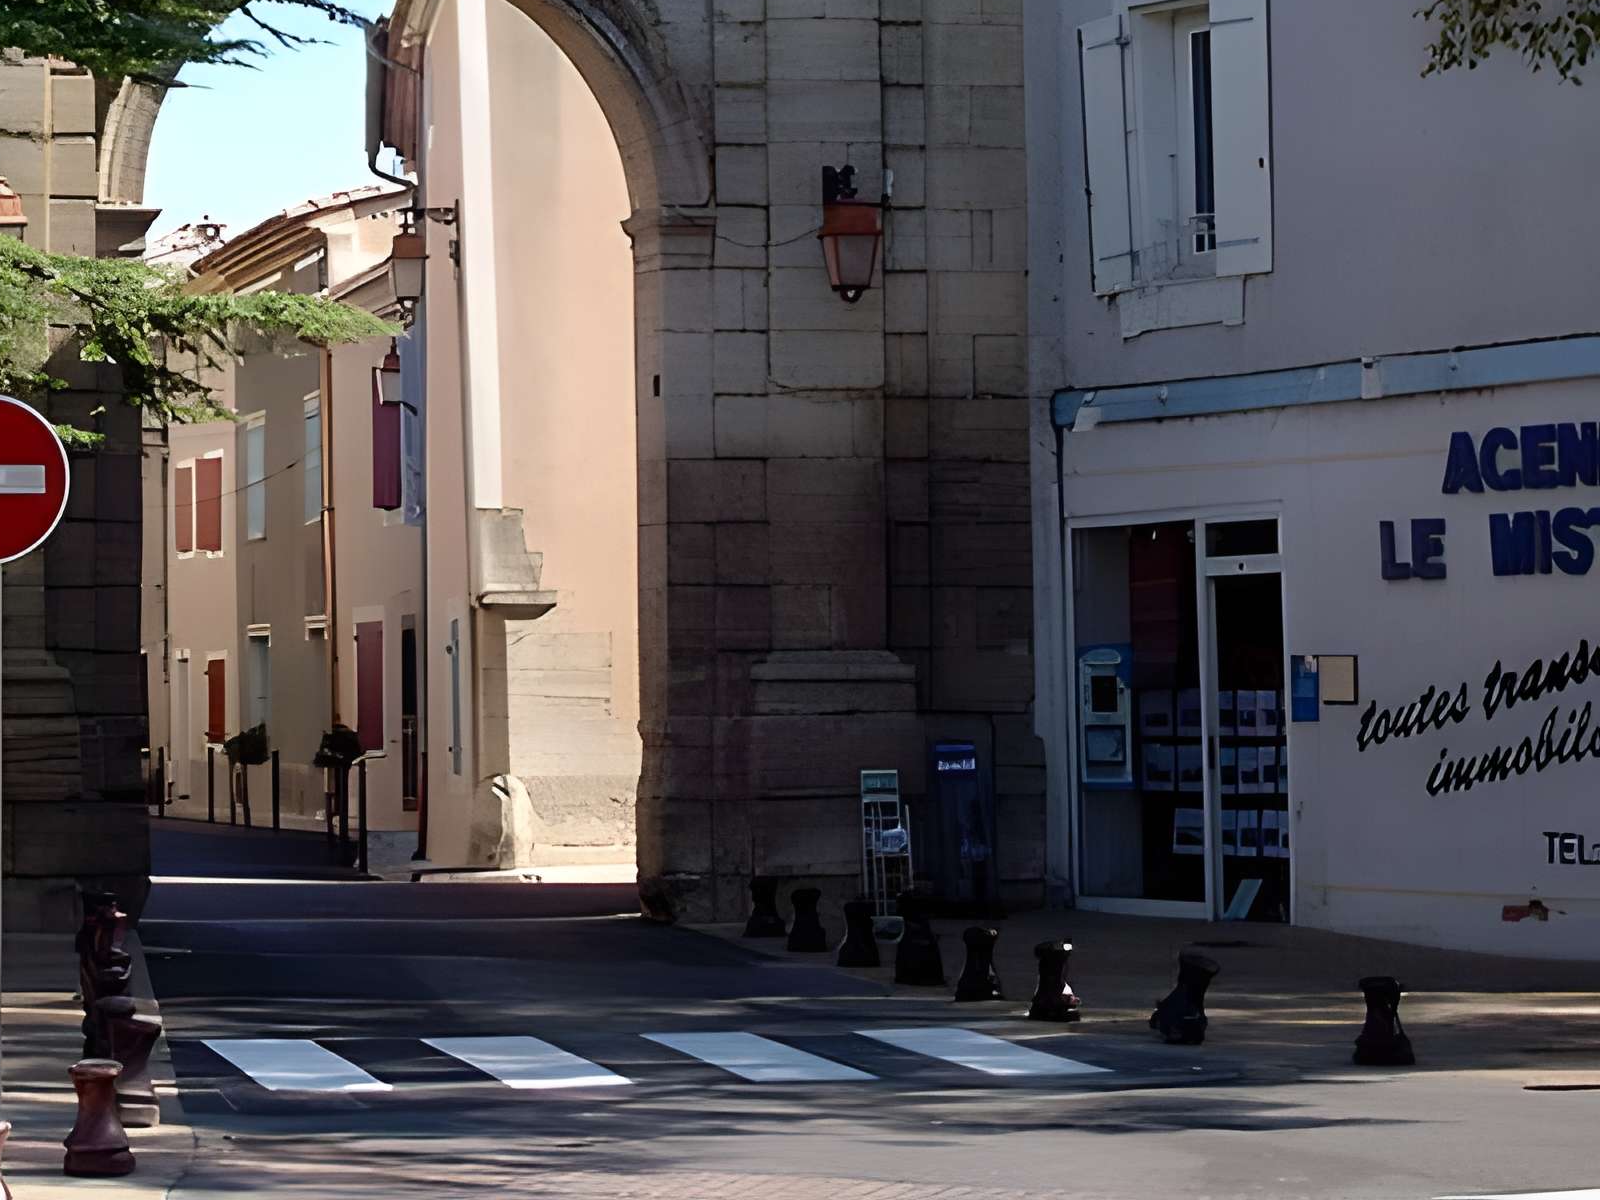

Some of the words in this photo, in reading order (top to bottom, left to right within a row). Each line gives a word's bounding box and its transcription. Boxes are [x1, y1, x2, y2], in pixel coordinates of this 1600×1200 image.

[1442, 422, 1600, 494] ACEN
[1380, 518, 1447, 581] LE
[1357, 683, 1470, 752] toutes
